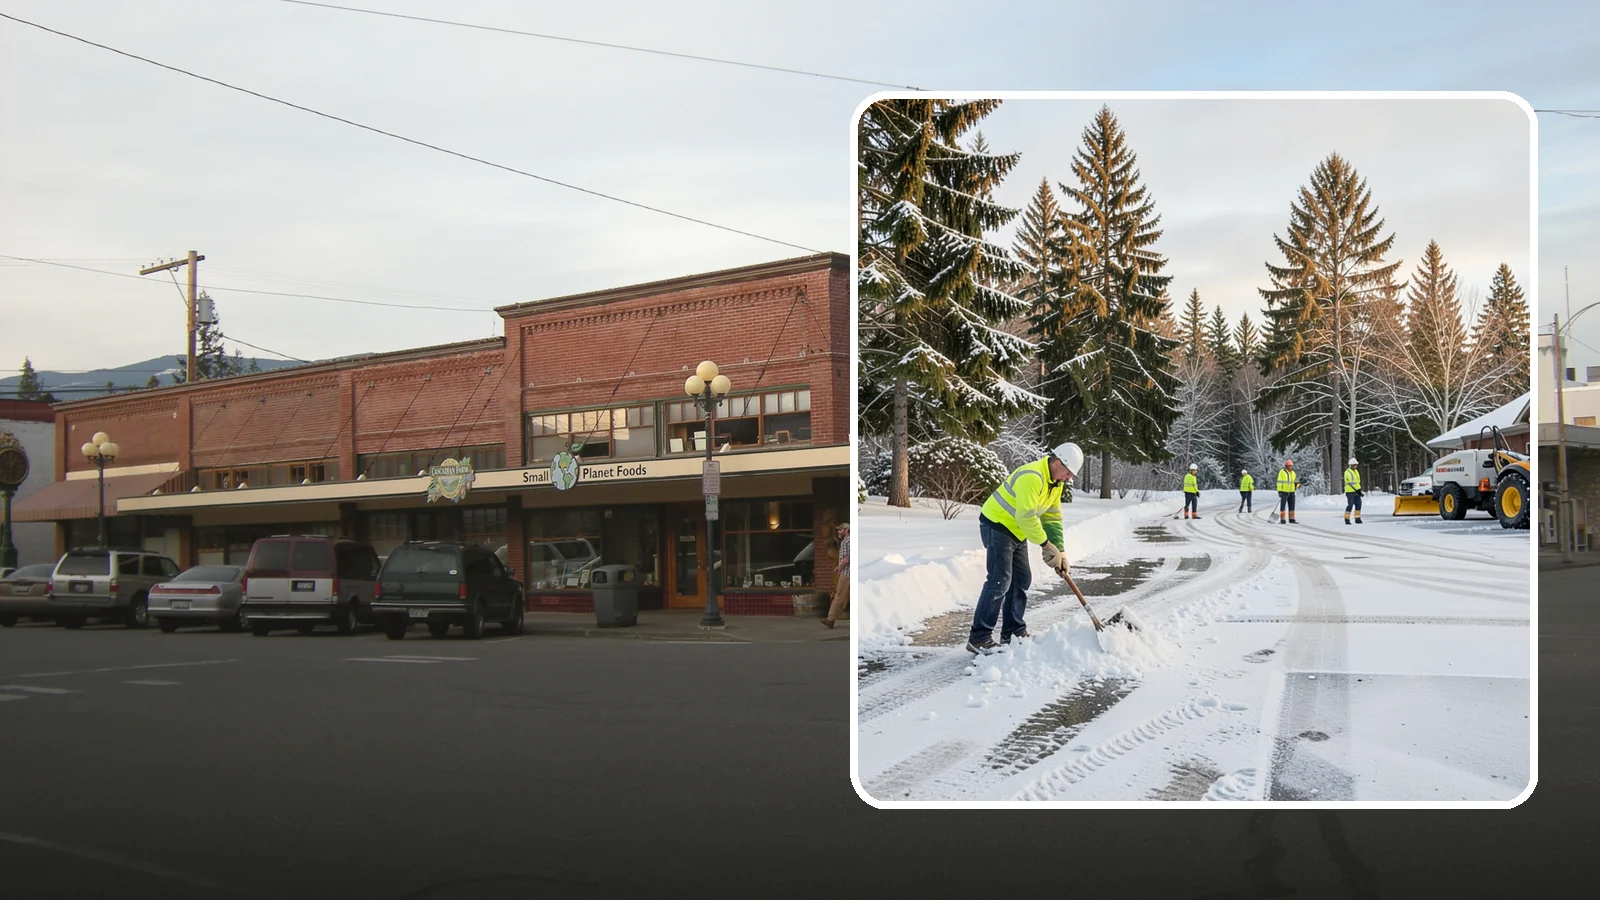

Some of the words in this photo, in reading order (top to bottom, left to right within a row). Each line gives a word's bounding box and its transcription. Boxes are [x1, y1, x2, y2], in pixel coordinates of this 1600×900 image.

[523, 471, 549, 482] Small
[583, 467, 614, 479] Planet
[617, 464, 647, 477] Foods
